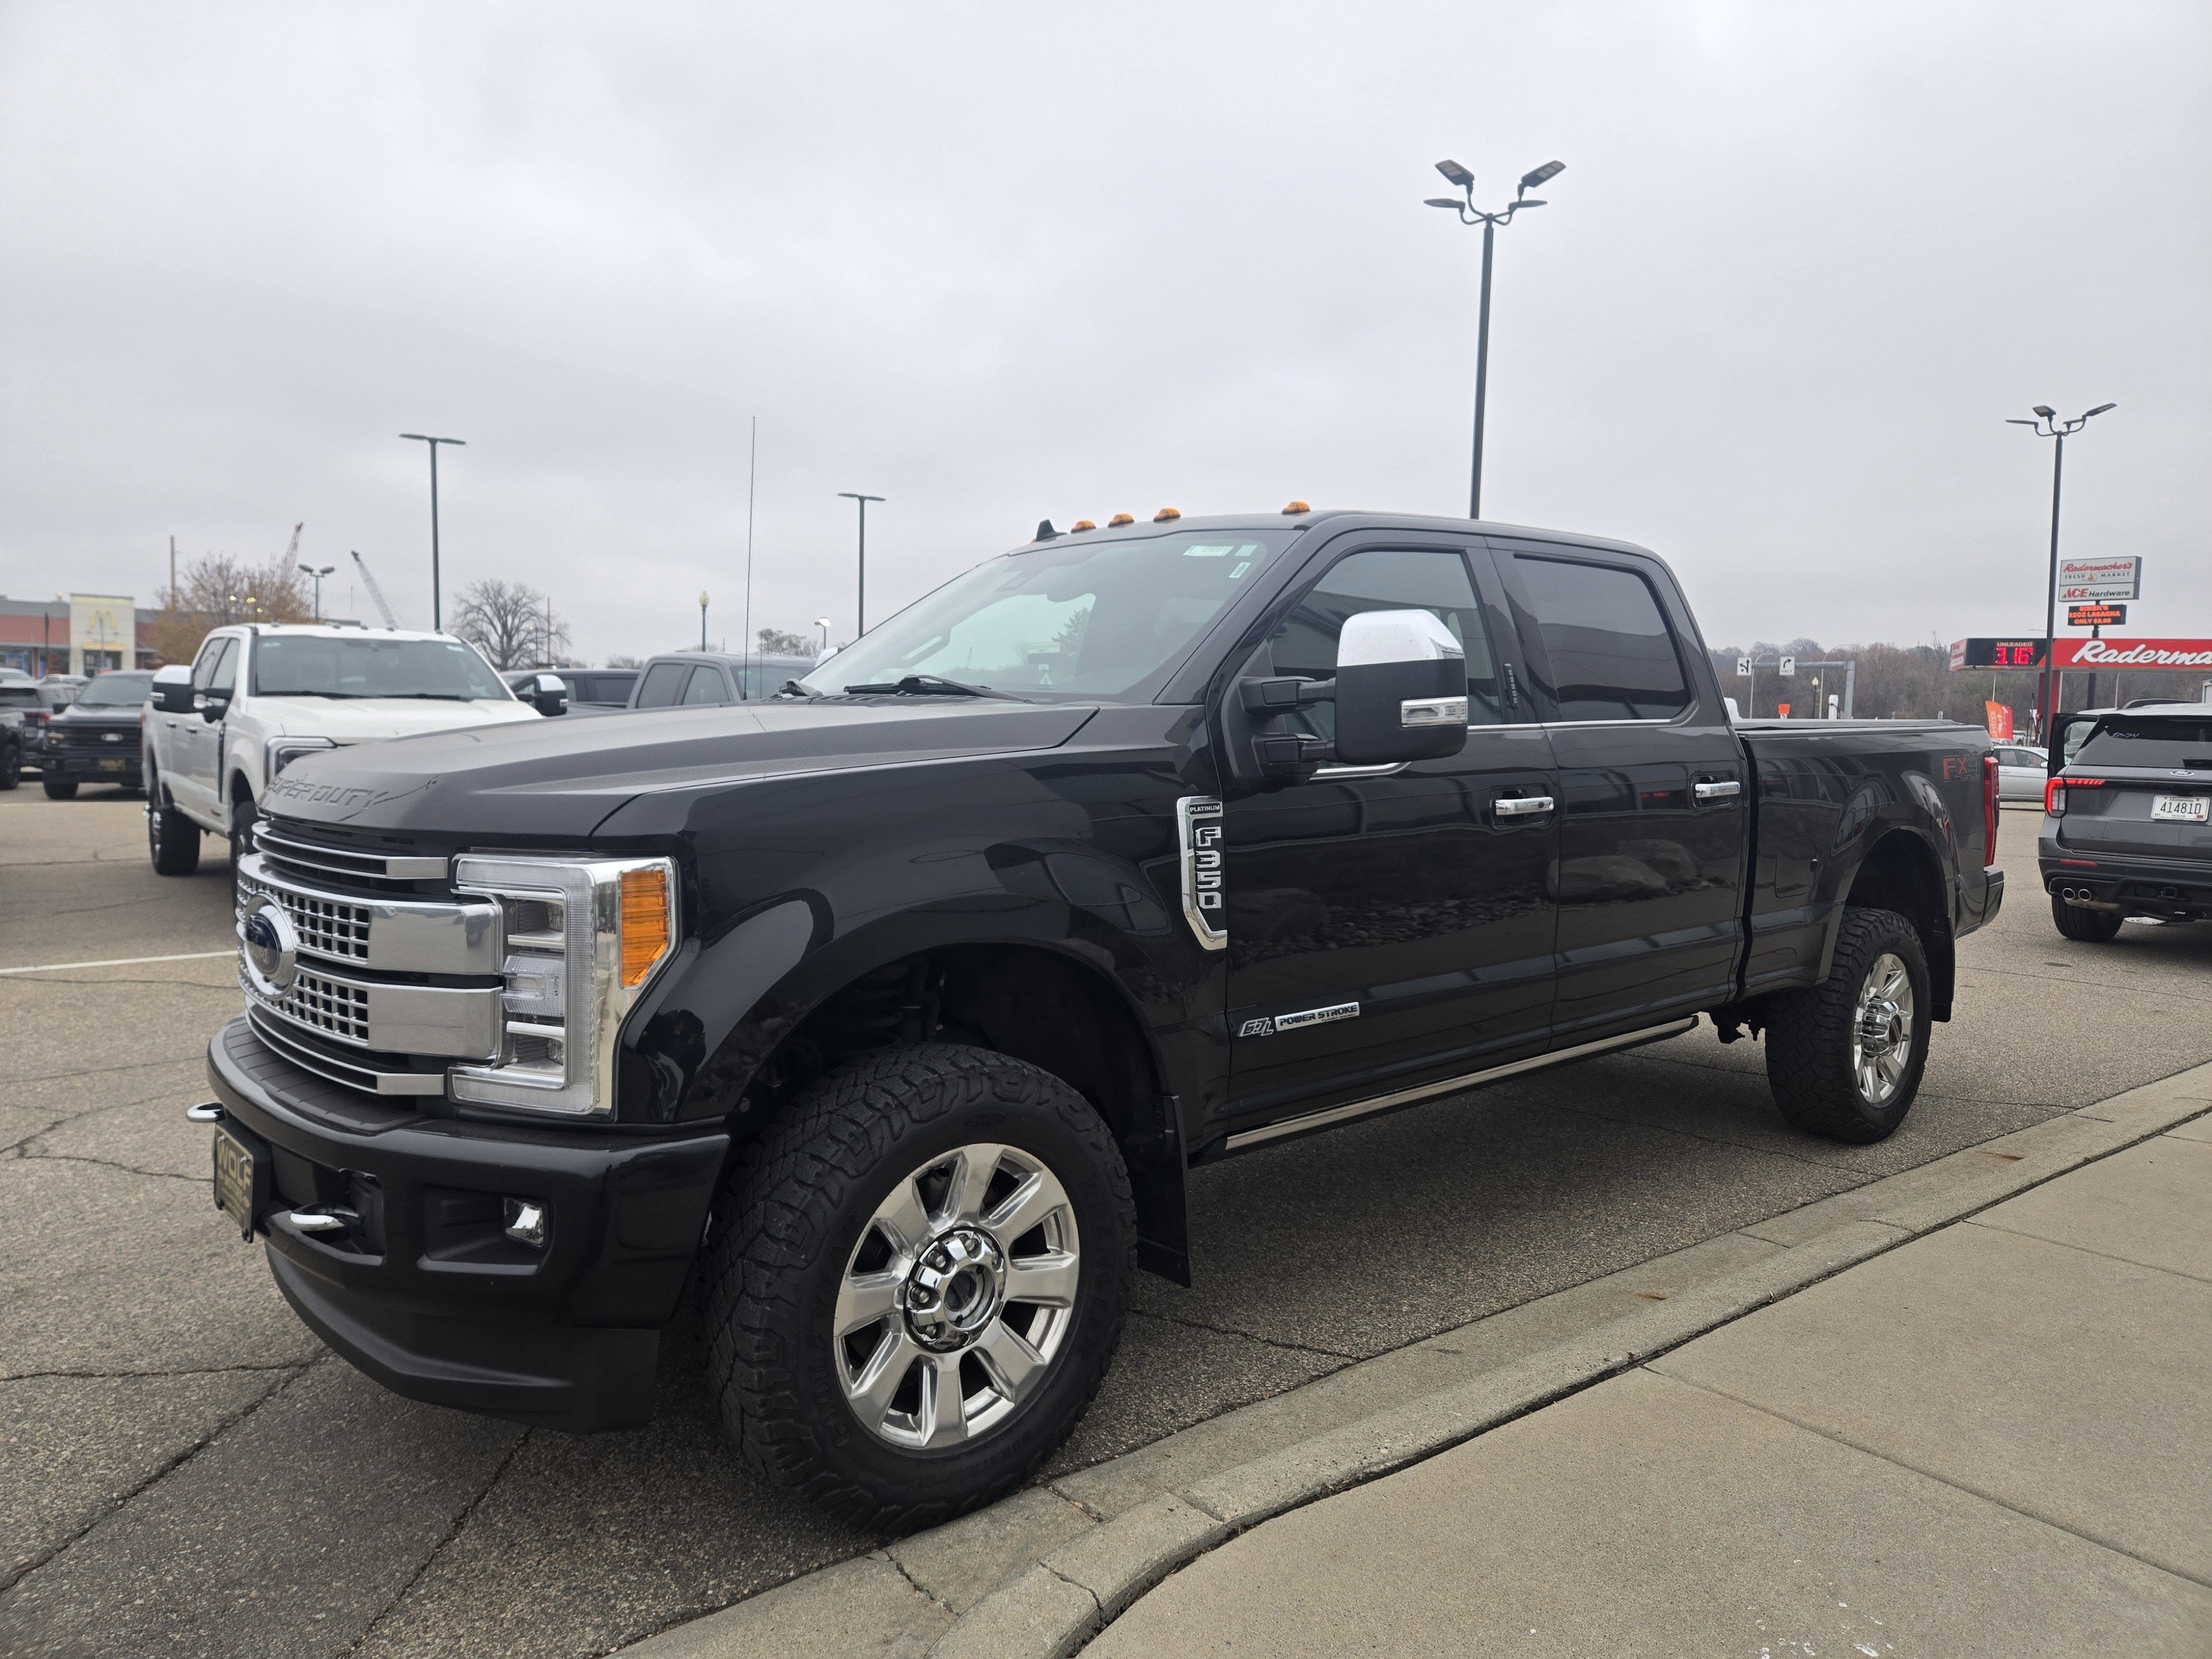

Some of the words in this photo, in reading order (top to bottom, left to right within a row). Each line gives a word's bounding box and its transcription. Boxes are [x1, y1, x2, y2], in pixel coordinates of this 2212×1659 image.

[2063, 562, 2133, 573] Radermacher's
[2062, 588, 2089, 598] ACE
[2072, 640, 2212, 665] Raderma
[1942, 754, 1980, 782] FX4
[307, 785, 389, 808] DUTY
[2160, 801, 2201, 814] 41481D
[1196, 826, 1222, 909] F350
[1239, 1016, 1274, 1036] 6.7L
[1279, 1013, 1316, 1026] POWER
[1317, 1005, 1358, 1019] STROKE
[217, 1140, 251, 1190] WOLF
